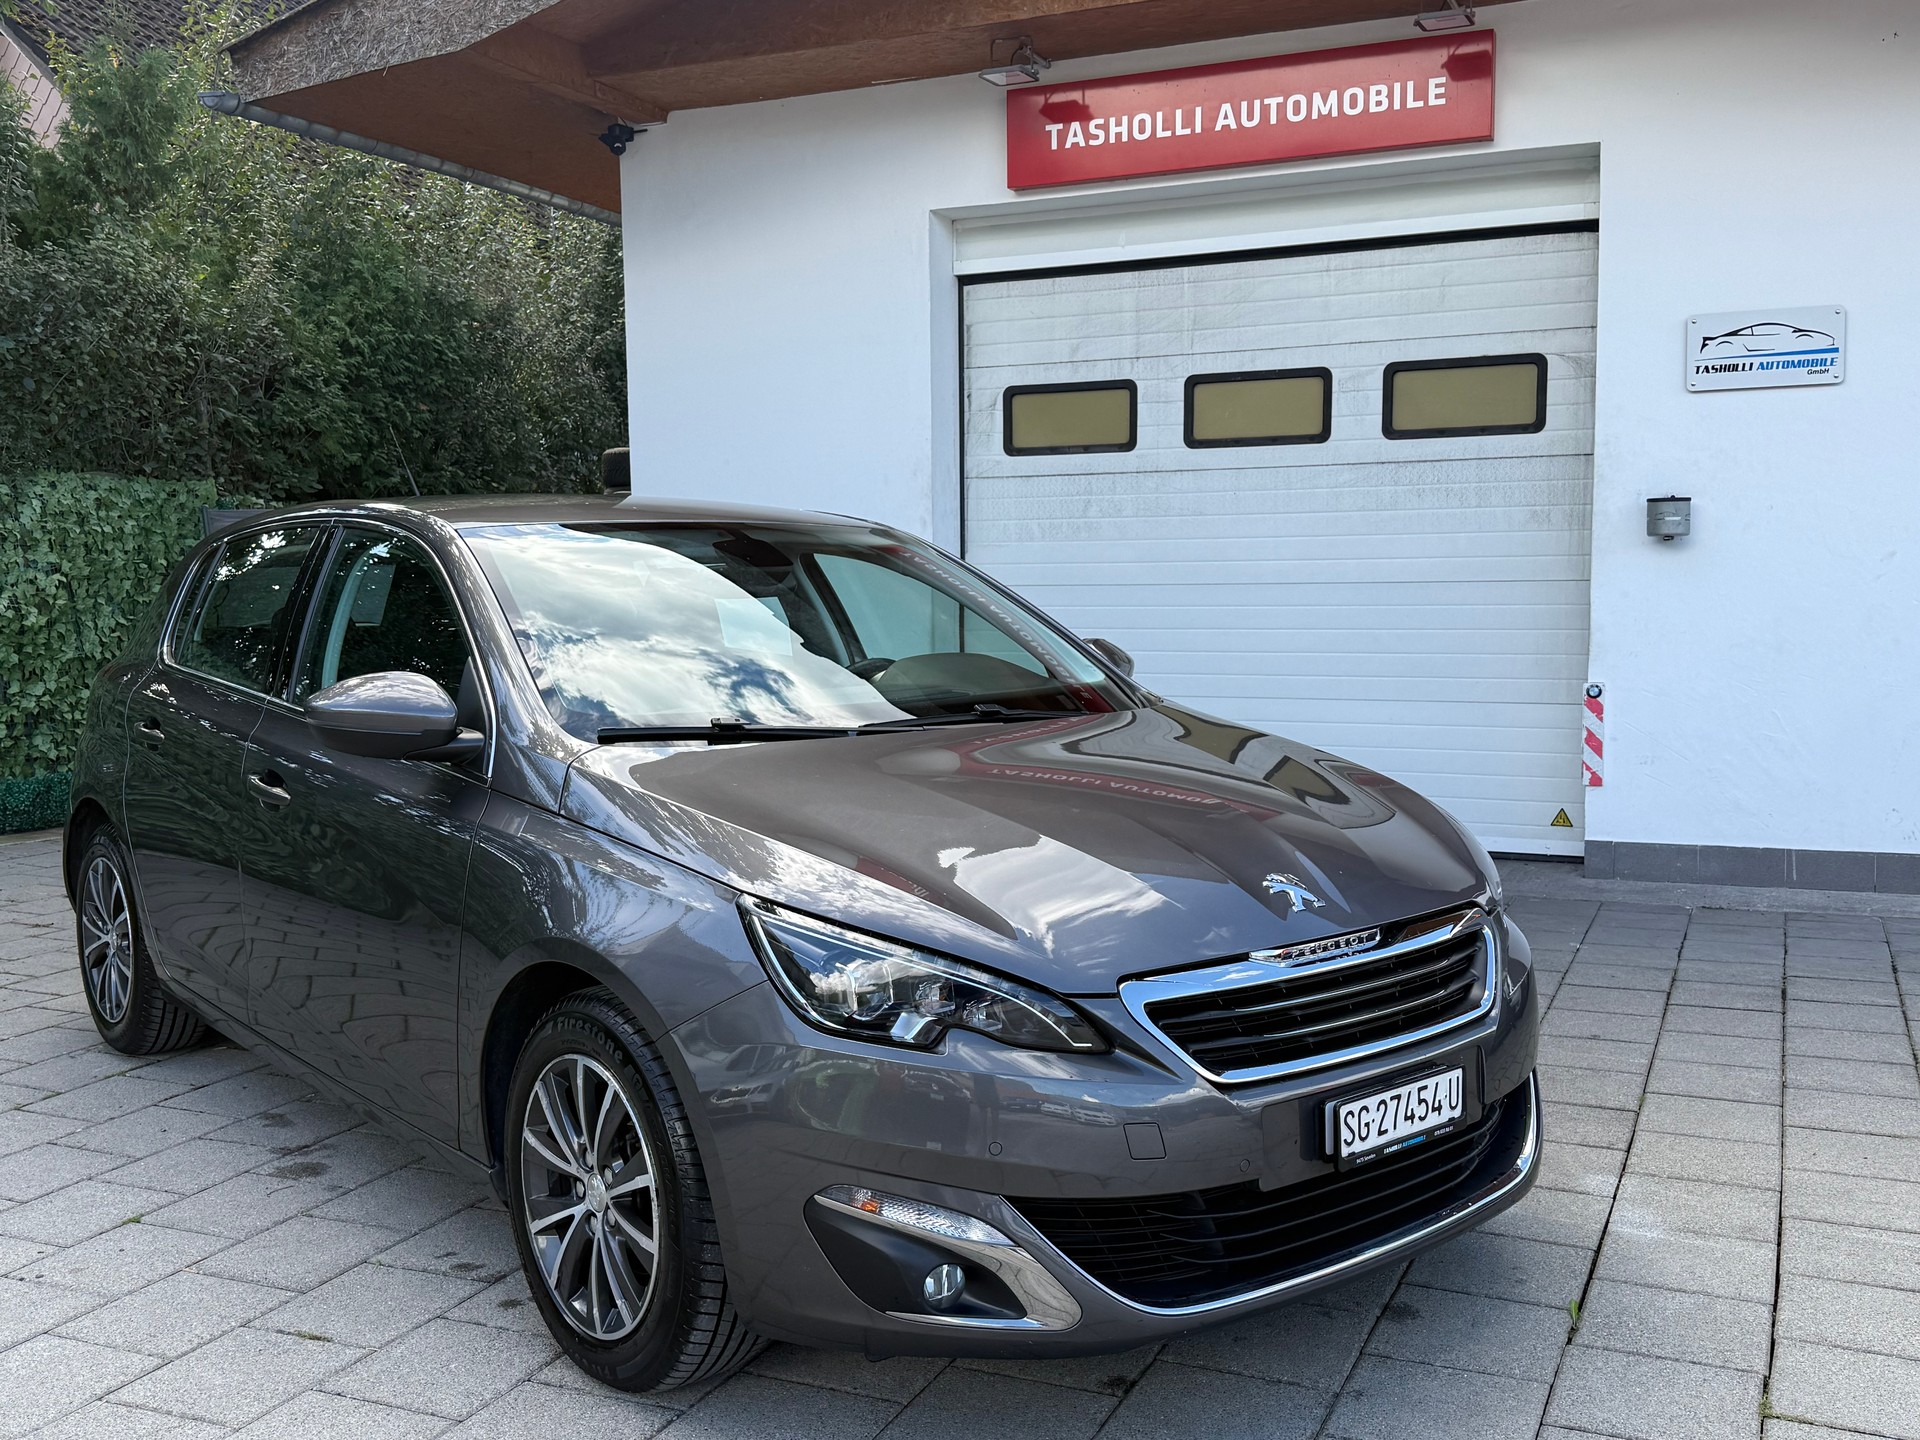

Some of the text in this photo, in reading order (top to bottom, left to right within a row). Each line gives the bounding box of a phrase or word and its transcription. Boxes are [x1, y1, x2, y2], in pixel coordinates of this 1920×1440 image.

[1045, 76, 1448, 151] TASHOLLI AUTOMOBILE
[1694, 357, 1838, 375] TASHOLLI AUTOMOBILE
[1807, 367, 1830, 376] GmbH
[1292, 933, 1369, 957] PEUGEOT
[556, 1015, 624, 1064] Firestone
